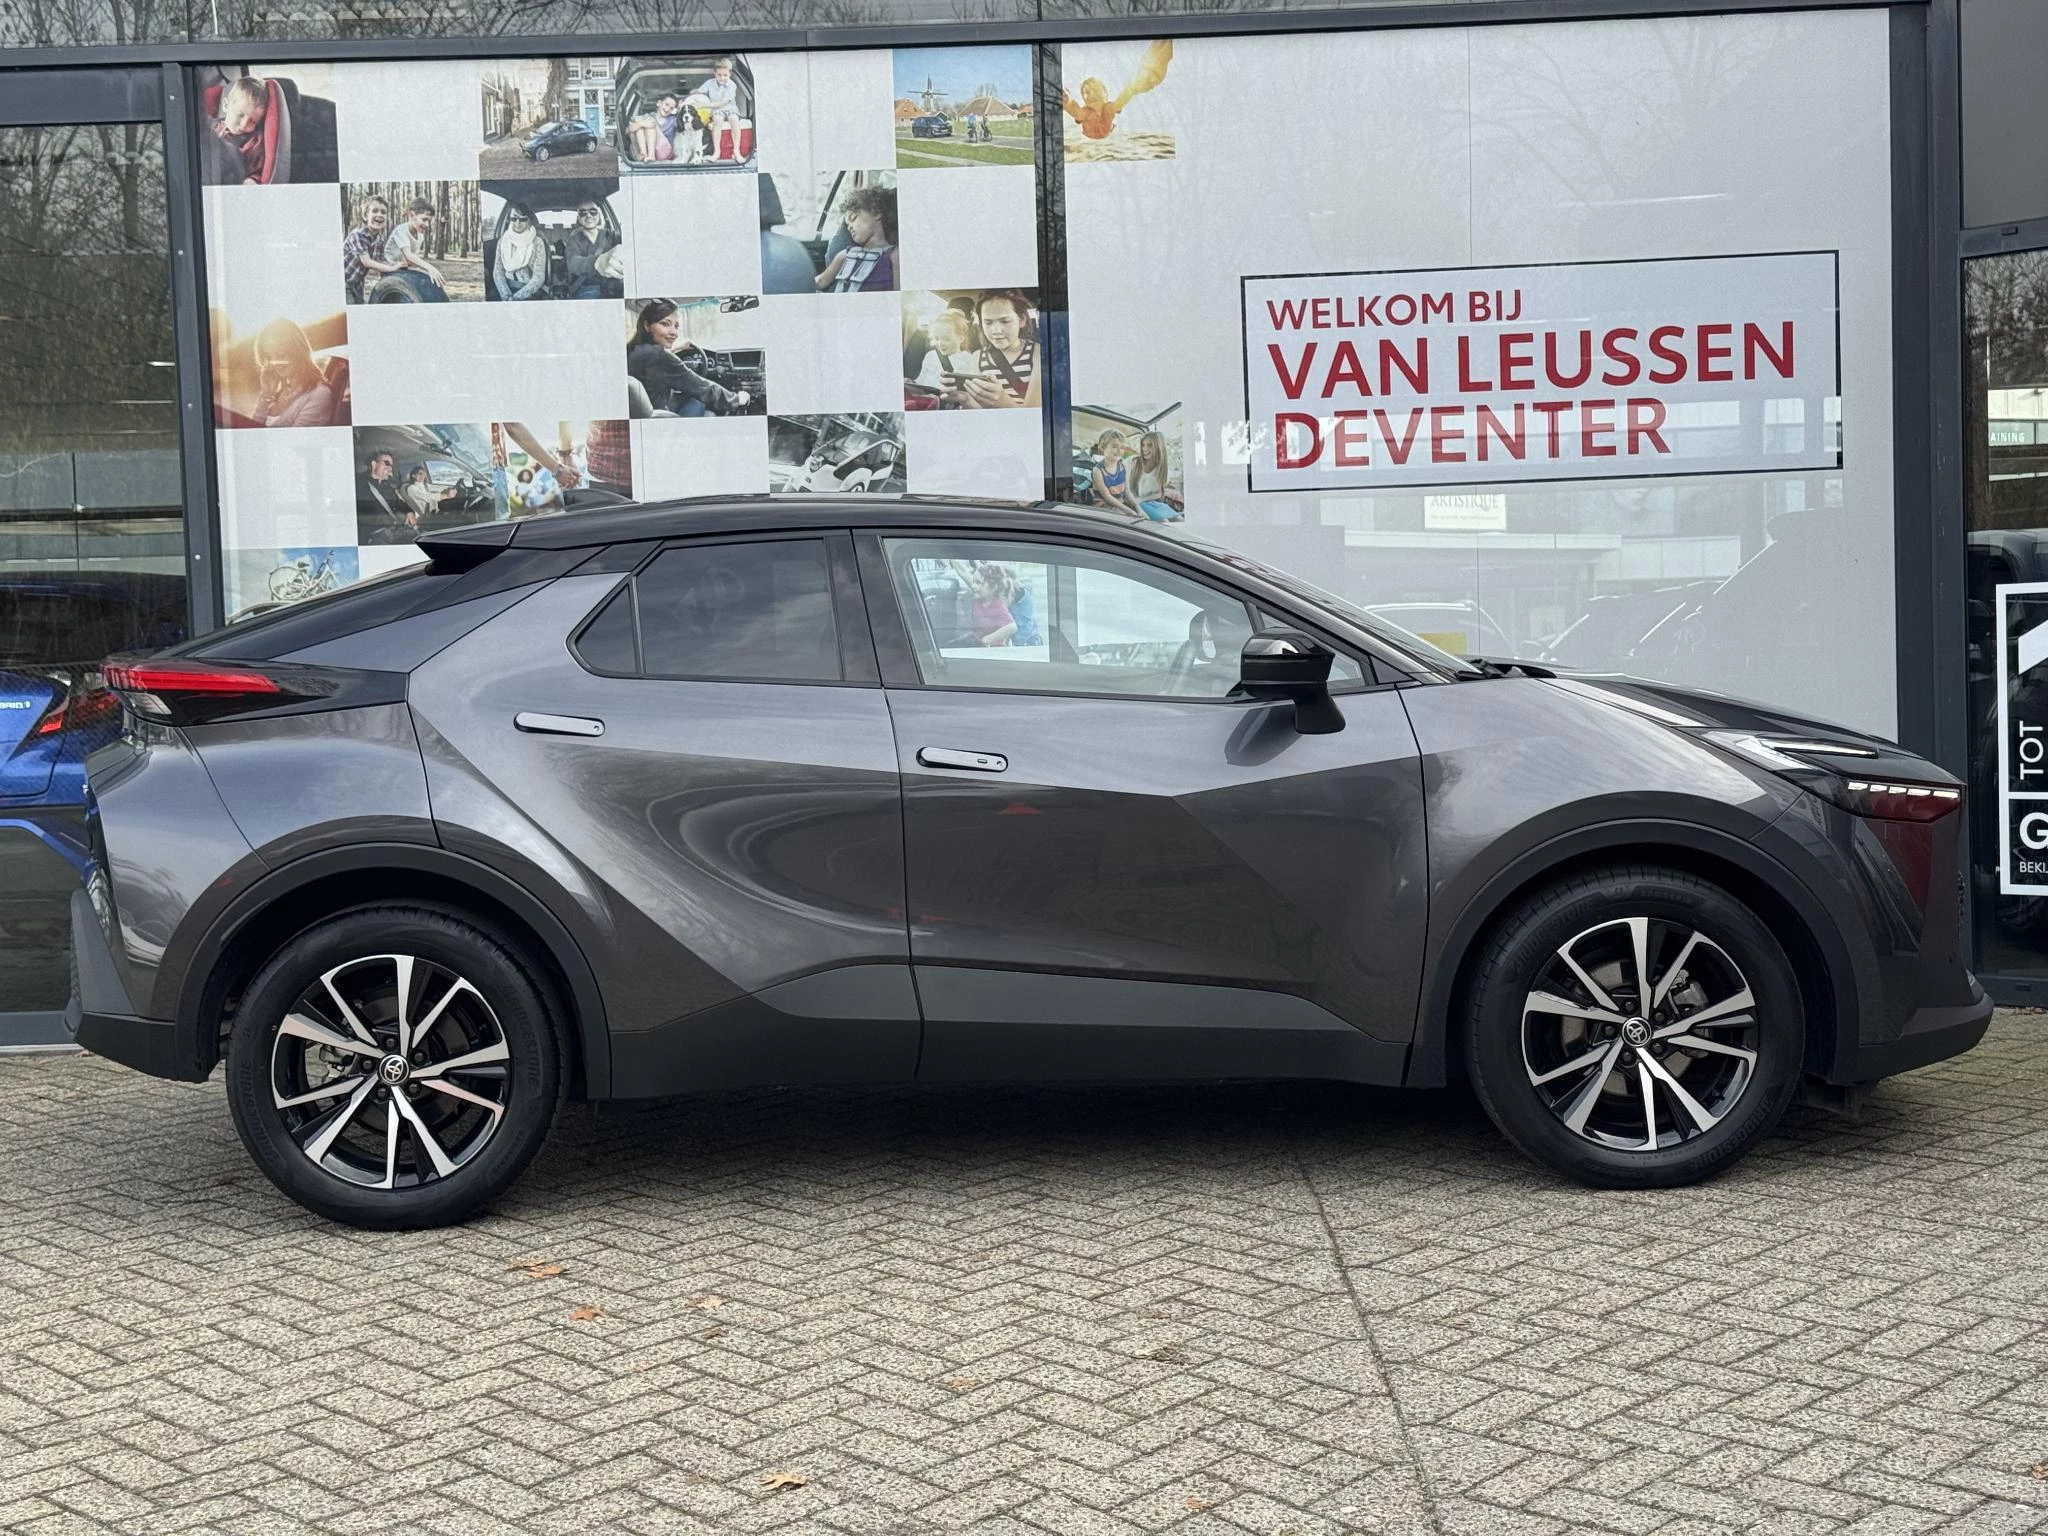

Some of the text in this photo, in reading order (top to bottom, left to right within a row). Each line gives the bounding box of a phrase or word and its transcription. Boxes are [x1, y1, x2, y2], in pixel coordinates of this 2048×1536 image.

[1267, 290, 1523, 330] WELKOM BIJ
[1267, 321, 1794, 399] VAN LEUSSEN
[1276, 398, 1671, 469] DEVENTER
[1431, 495, 1499, 511] ARTISTIQUE
[2019, 720, 2044, 780] TOT
